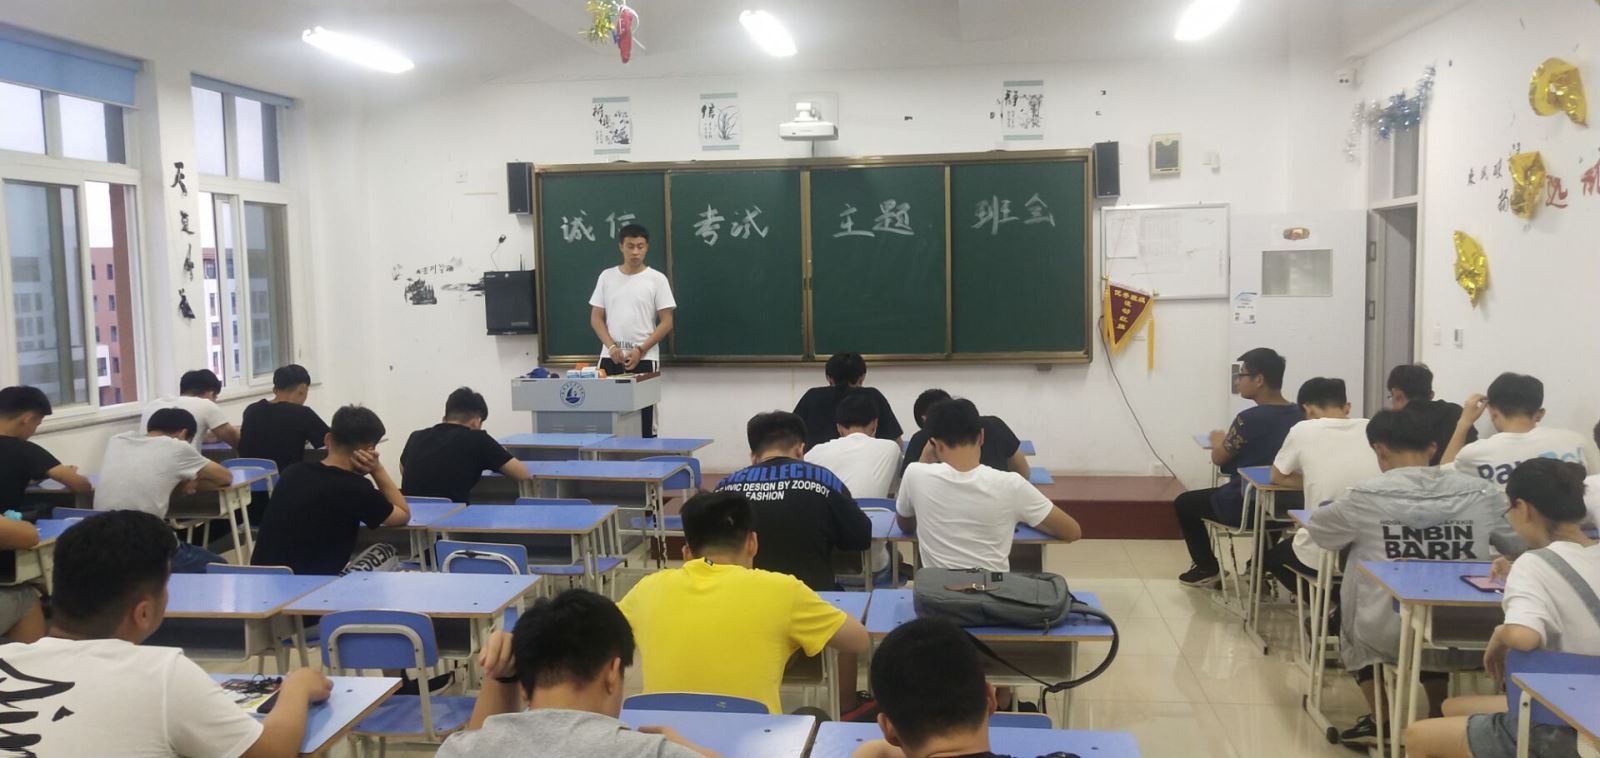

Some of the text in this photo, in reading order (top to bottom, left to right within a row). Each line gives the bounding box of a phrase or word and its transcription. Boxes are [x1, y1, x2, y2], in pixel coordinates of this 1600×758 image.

[693, 204, 769, 246] 考试
[833, 199, 915, 238] 主题
[971, 193, 1056, 235] 班会
[743, 482, 776, 492] DESIGN
[778, 481, 790, 491] BY
[792, 480, 831, 498] ZOOPBOY
[746, 490, 785, 501] FASHION
[1384, 541, 1478, 560] BARK
